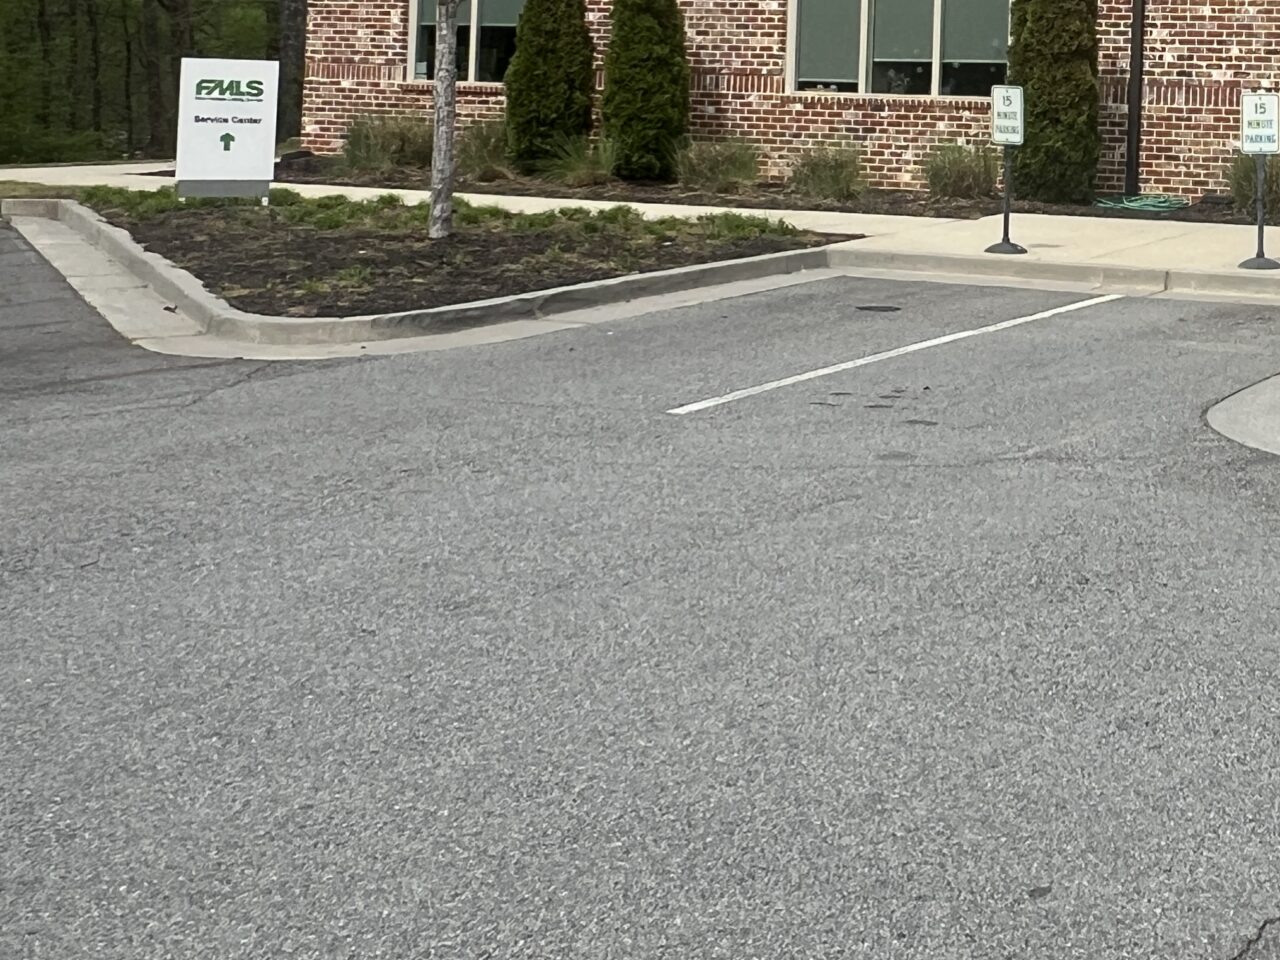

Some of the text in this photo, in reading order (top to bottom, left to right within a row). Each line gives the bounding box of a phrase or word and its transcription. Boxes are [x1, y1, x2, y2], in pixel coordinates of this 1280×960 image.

[195, 79, 264, 97] FMLS
[1002, 95, 1013, 107] 15
[1254, 102, 1267, 115] 15
[194, 115, 262, 124] Service Center
[1244, 134, 1277, 144] PARKING
